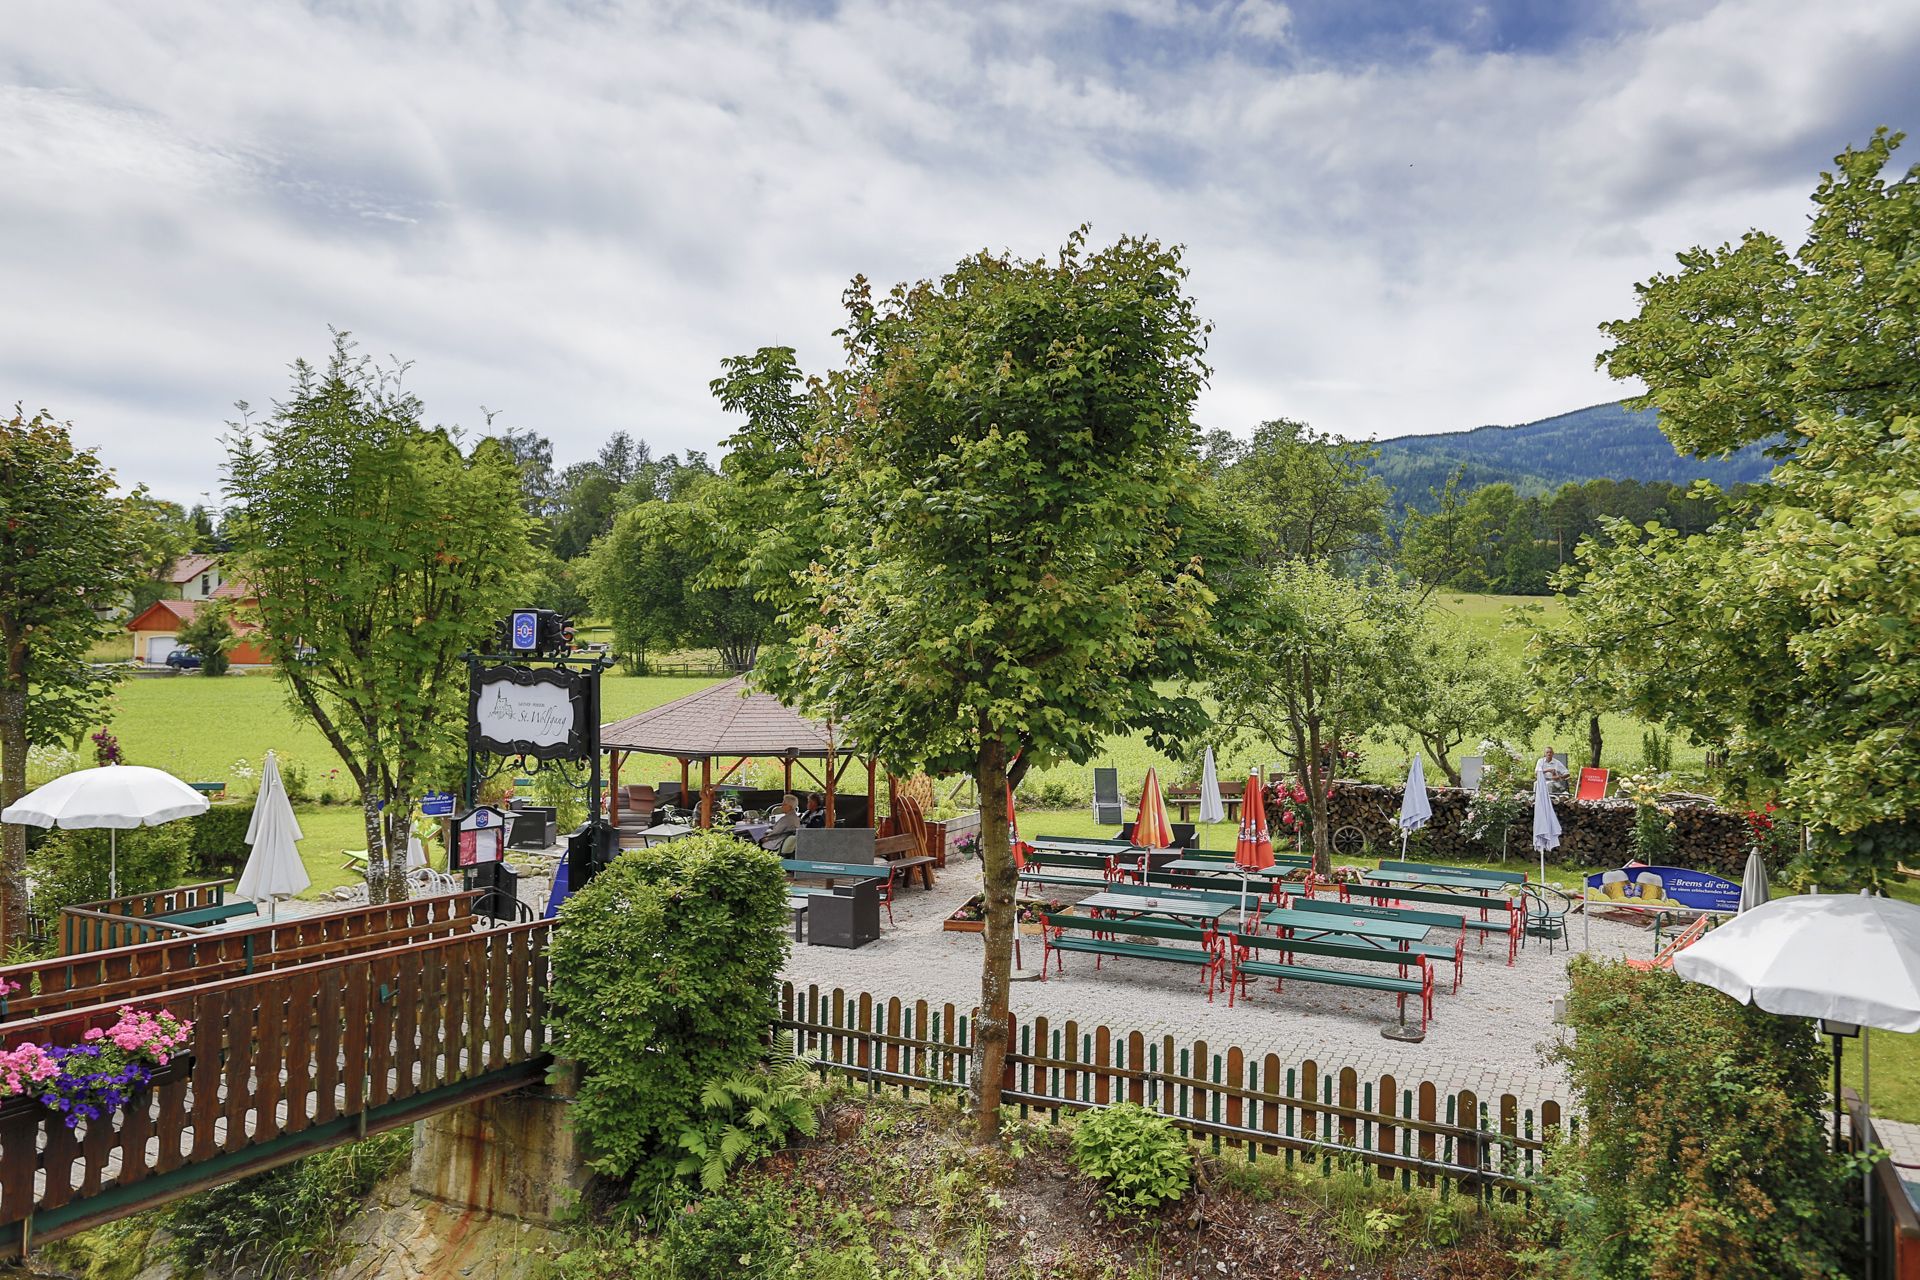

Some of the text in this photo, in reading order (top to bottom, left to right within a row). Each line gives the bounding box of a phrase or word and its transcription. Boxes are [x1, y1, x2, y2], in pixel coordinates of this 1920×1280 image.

[518, 705, 567, 736] St. Wolfgang
[1676, 879, 1702, 888] Brems
